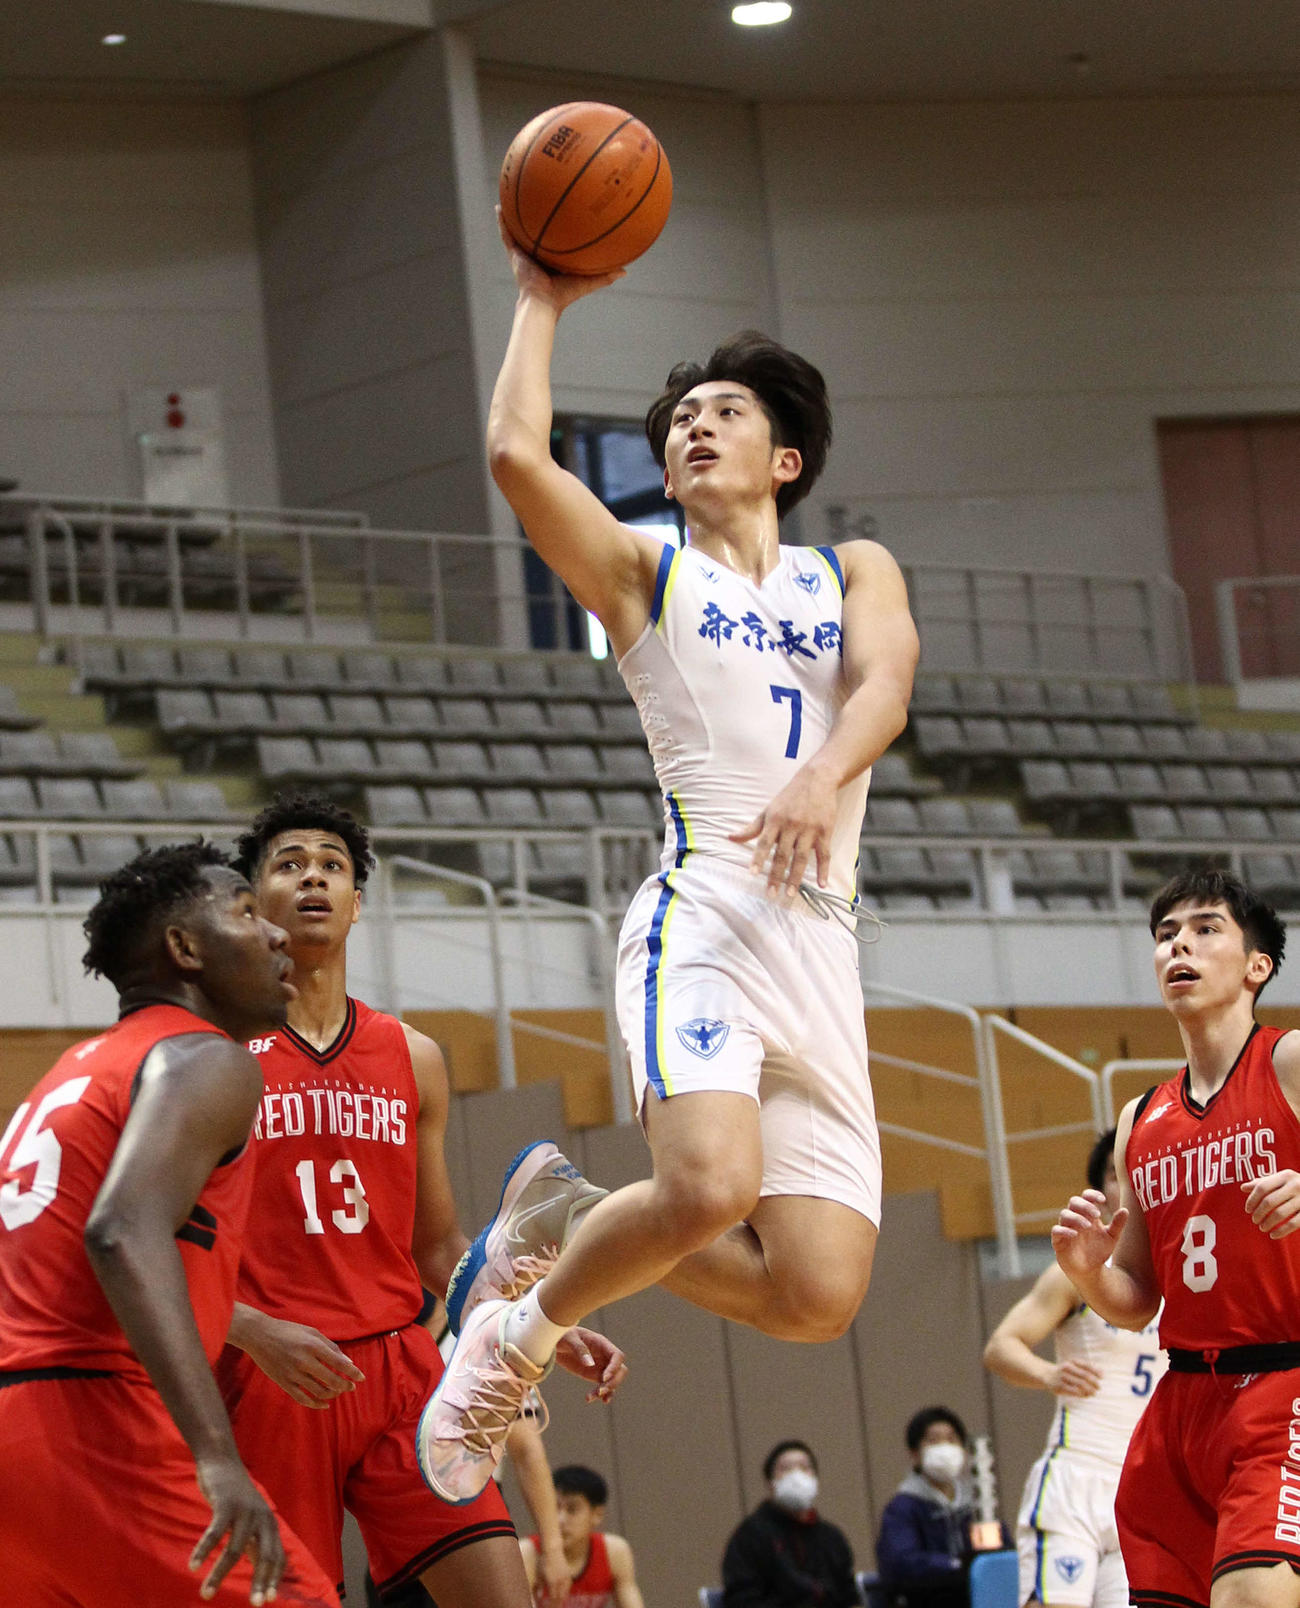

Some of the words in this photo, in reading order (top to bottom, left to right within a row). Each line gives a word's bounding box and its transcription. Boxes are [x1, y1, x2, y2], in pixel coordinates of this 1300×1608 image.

[542, 125, 574, 158] FIBA
[769, 684, 802, 760] 7
[264, 1079, 399, 1097] AISHIKOKUSAI
[306, 1088, 407, 1146] TIGERS
[295, 1159, 370, 1235] 13
[1132, 1154, 1178, 1213] RED
[1181, 1128, 1277, 1197] TIGERS
[1180, 1213, 1219, 1294] 8
[1131, 1354, 1156, 1397] 5
